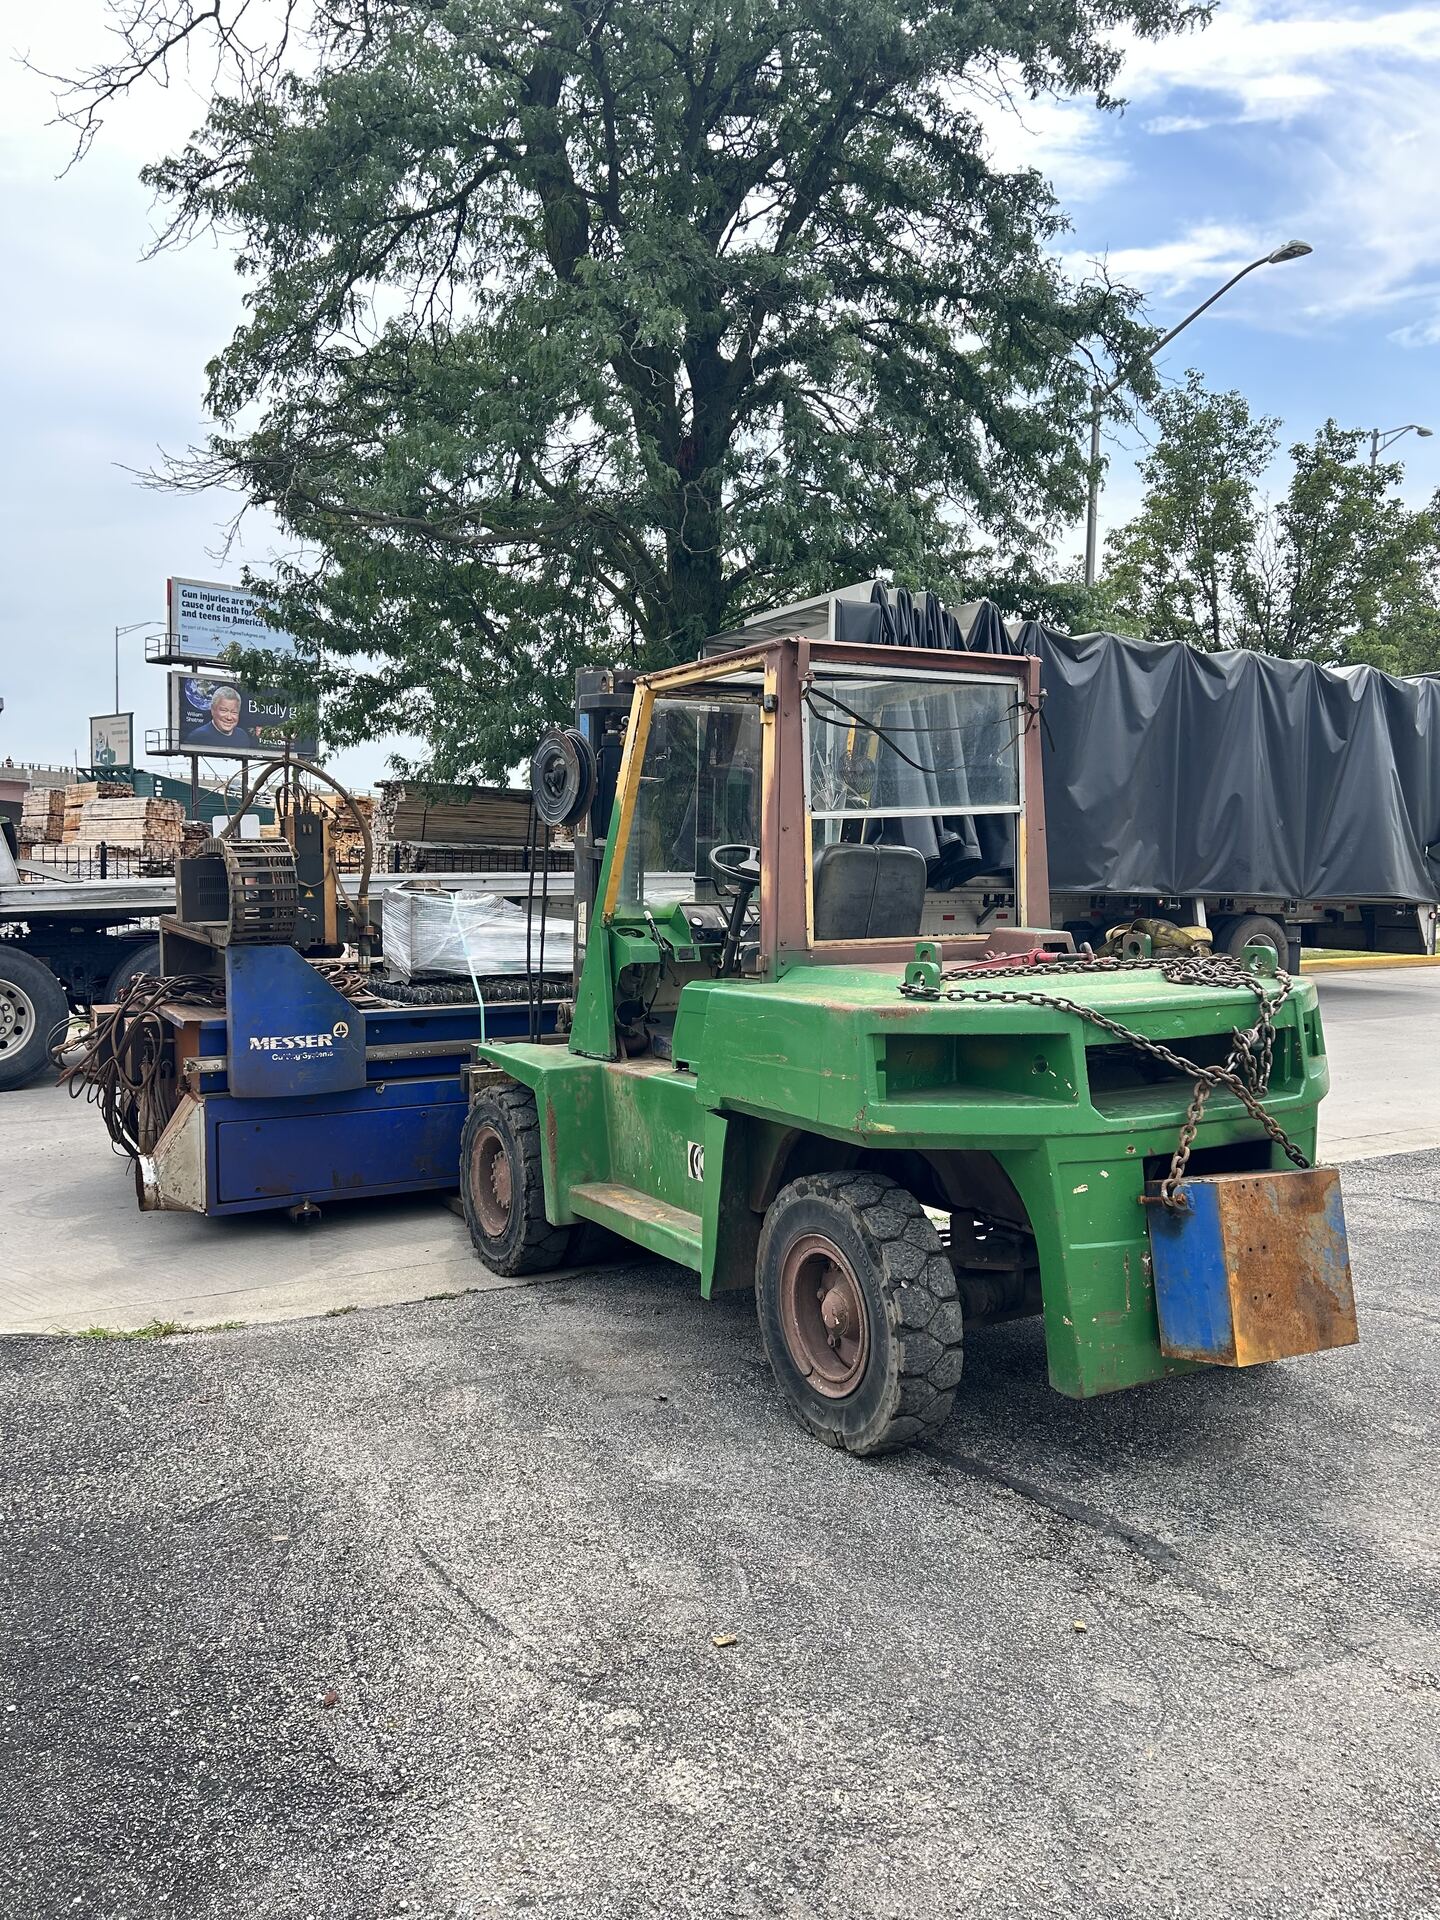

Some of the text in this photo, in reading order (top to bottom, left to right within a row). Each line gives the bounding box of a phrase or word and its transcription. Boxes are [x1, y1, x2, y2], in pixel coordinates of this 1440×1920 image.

[182, 589, 198, 600] Gun
[200, 591, 230, 604] injuries
[231, 598, 244, 606] are
[182, 600, 252, 617] cause of death for
[182, 610, 197, 619] and
[199, 611, 221, 622] teens
[222, 615, 230, 623] in
[249, 1034, 333, 1050] MESSER
